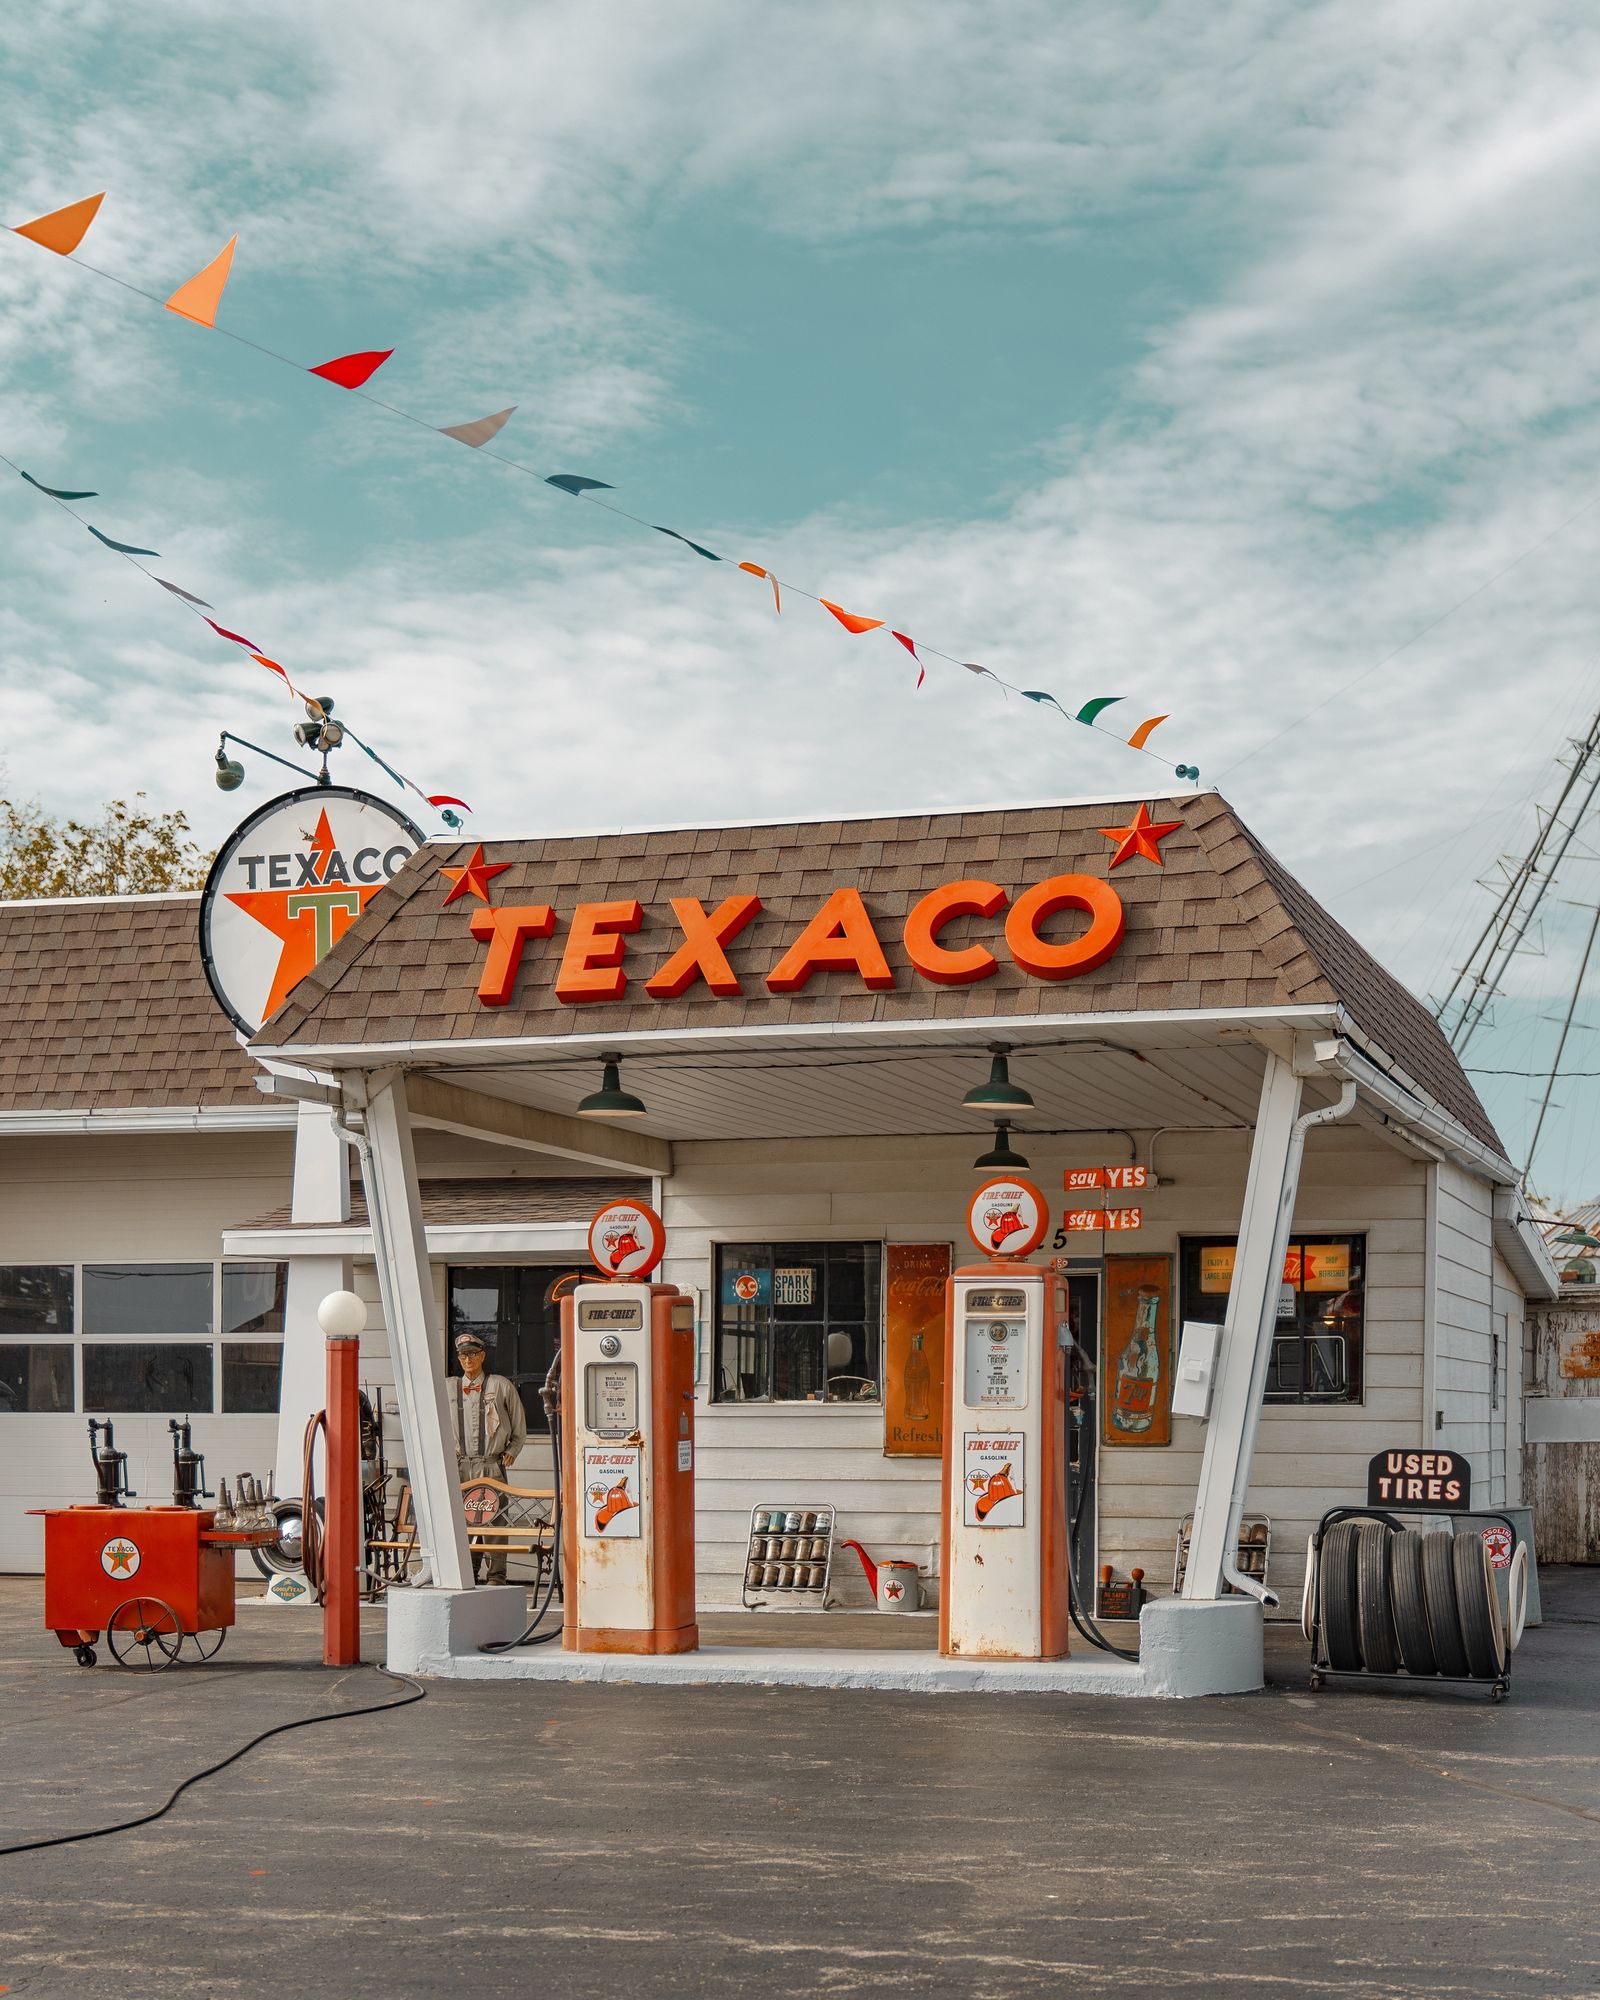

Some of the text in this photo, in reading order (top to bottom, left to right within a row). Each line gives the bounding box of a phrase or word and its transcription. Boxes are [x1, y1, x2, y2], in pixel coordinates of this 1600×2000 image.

[238, 845, 413, 890] TEXACO
[469, 873, 1127, 1007] TEXACO
[1069, 1166, 1146, 1188] say YES
[982, 1191, 1025, 1200] FIRE-CHIEF
[601, 1213, 641, 1223] FIRE-CHIEF
[1068, 1208, 1140, 1231] say YES
[903, 1260, 932, 1269] DRINK
[1204, 1271, 1220, 1280] LARGE
[775, 1275, 810, 1289] SPARK
[775, 1289, 810, 1303] PLUGS
[970, 1295, 1025, 1307] FIRE-CHIEF
[587, 1308, 637, 1320] FIRE-CHIEF
[967, 1440, 1021, 1451] FIRE-CHIEF
[586, 1454, 636, 1465] FIRE-CHIEF
[1387, 1453, 1453, 1476] USED
[1379, 1477, 1462, 1501] TIRES
[108, 1545, 135, 1553] TEXACO
